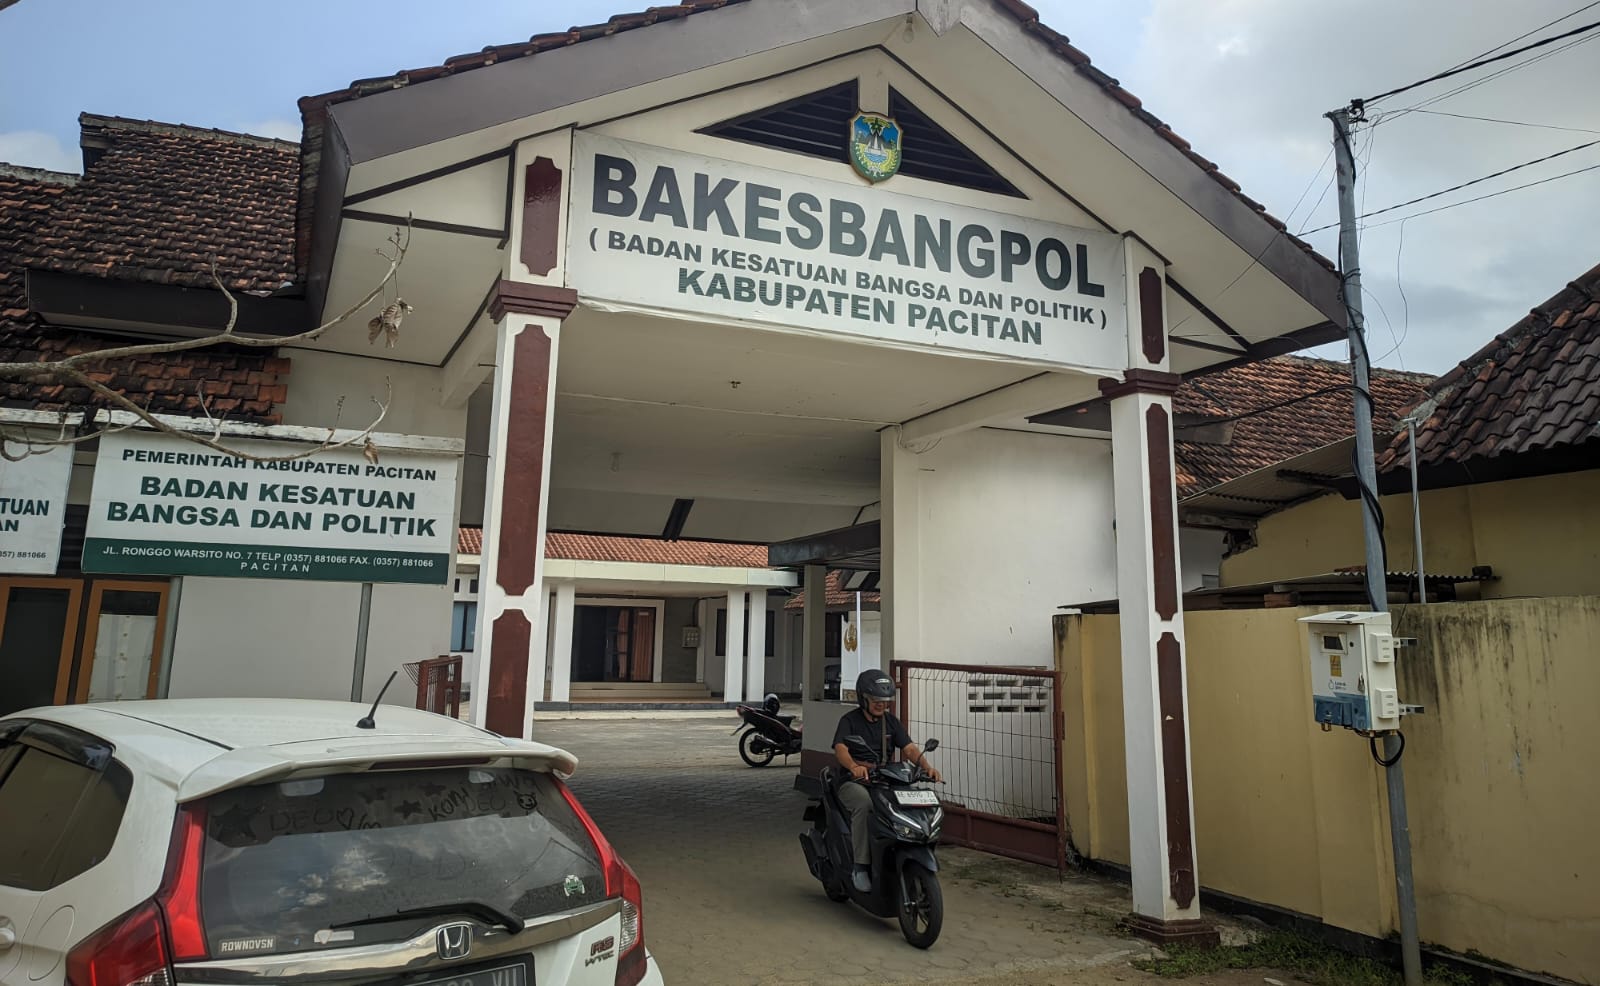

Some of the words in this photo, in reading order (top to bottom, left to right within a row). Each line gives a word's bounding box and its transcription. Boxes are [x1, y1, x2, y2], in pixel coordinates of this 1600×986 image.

[592, 153, 1104, 298] BAKESBANGPOL
[608, 230, 702, 262] BADAN
[712, 248, 846, 286] KESATUAN
[856, 271, 951, 302] BANGSA
[959, 288, 1003, 310] DAN
[1011, 296, 1095, 325] POLITIK
[678, 267, 895, 324] KABUPATEN
[908, 303, 1042, 345] PACITAN
[122, 449, 246, 468] PEMERINTAH
[365, 465, 437, 481] PACITAN
[140, 476, 248, 500] BADAN
[259, 484, 416, 510] KESATUAN
[107, 502, 240, 527] BANGSA
[251, 509, 312, 530] DAN
[322, 513, 437, 537] POLITIK
[103, 546, 119, 555] JL.
[122, 547, 171, 557] RONGGO
[174, 549, 222, 559] WARSITO
[225, 551, 243, 560] NO.
[247, 552, 253, 560] 7
[256, 552, 281, 561] TELP
[283, 553, 312, 563] (0357)
[314, 554, 347, 564] 881066
[349, 556, 371, 565] FAX.
[373, 557, 400, 567] (0357)
[402, 558, 434, 568] 881066
[590, 936, 614, 956] RS
